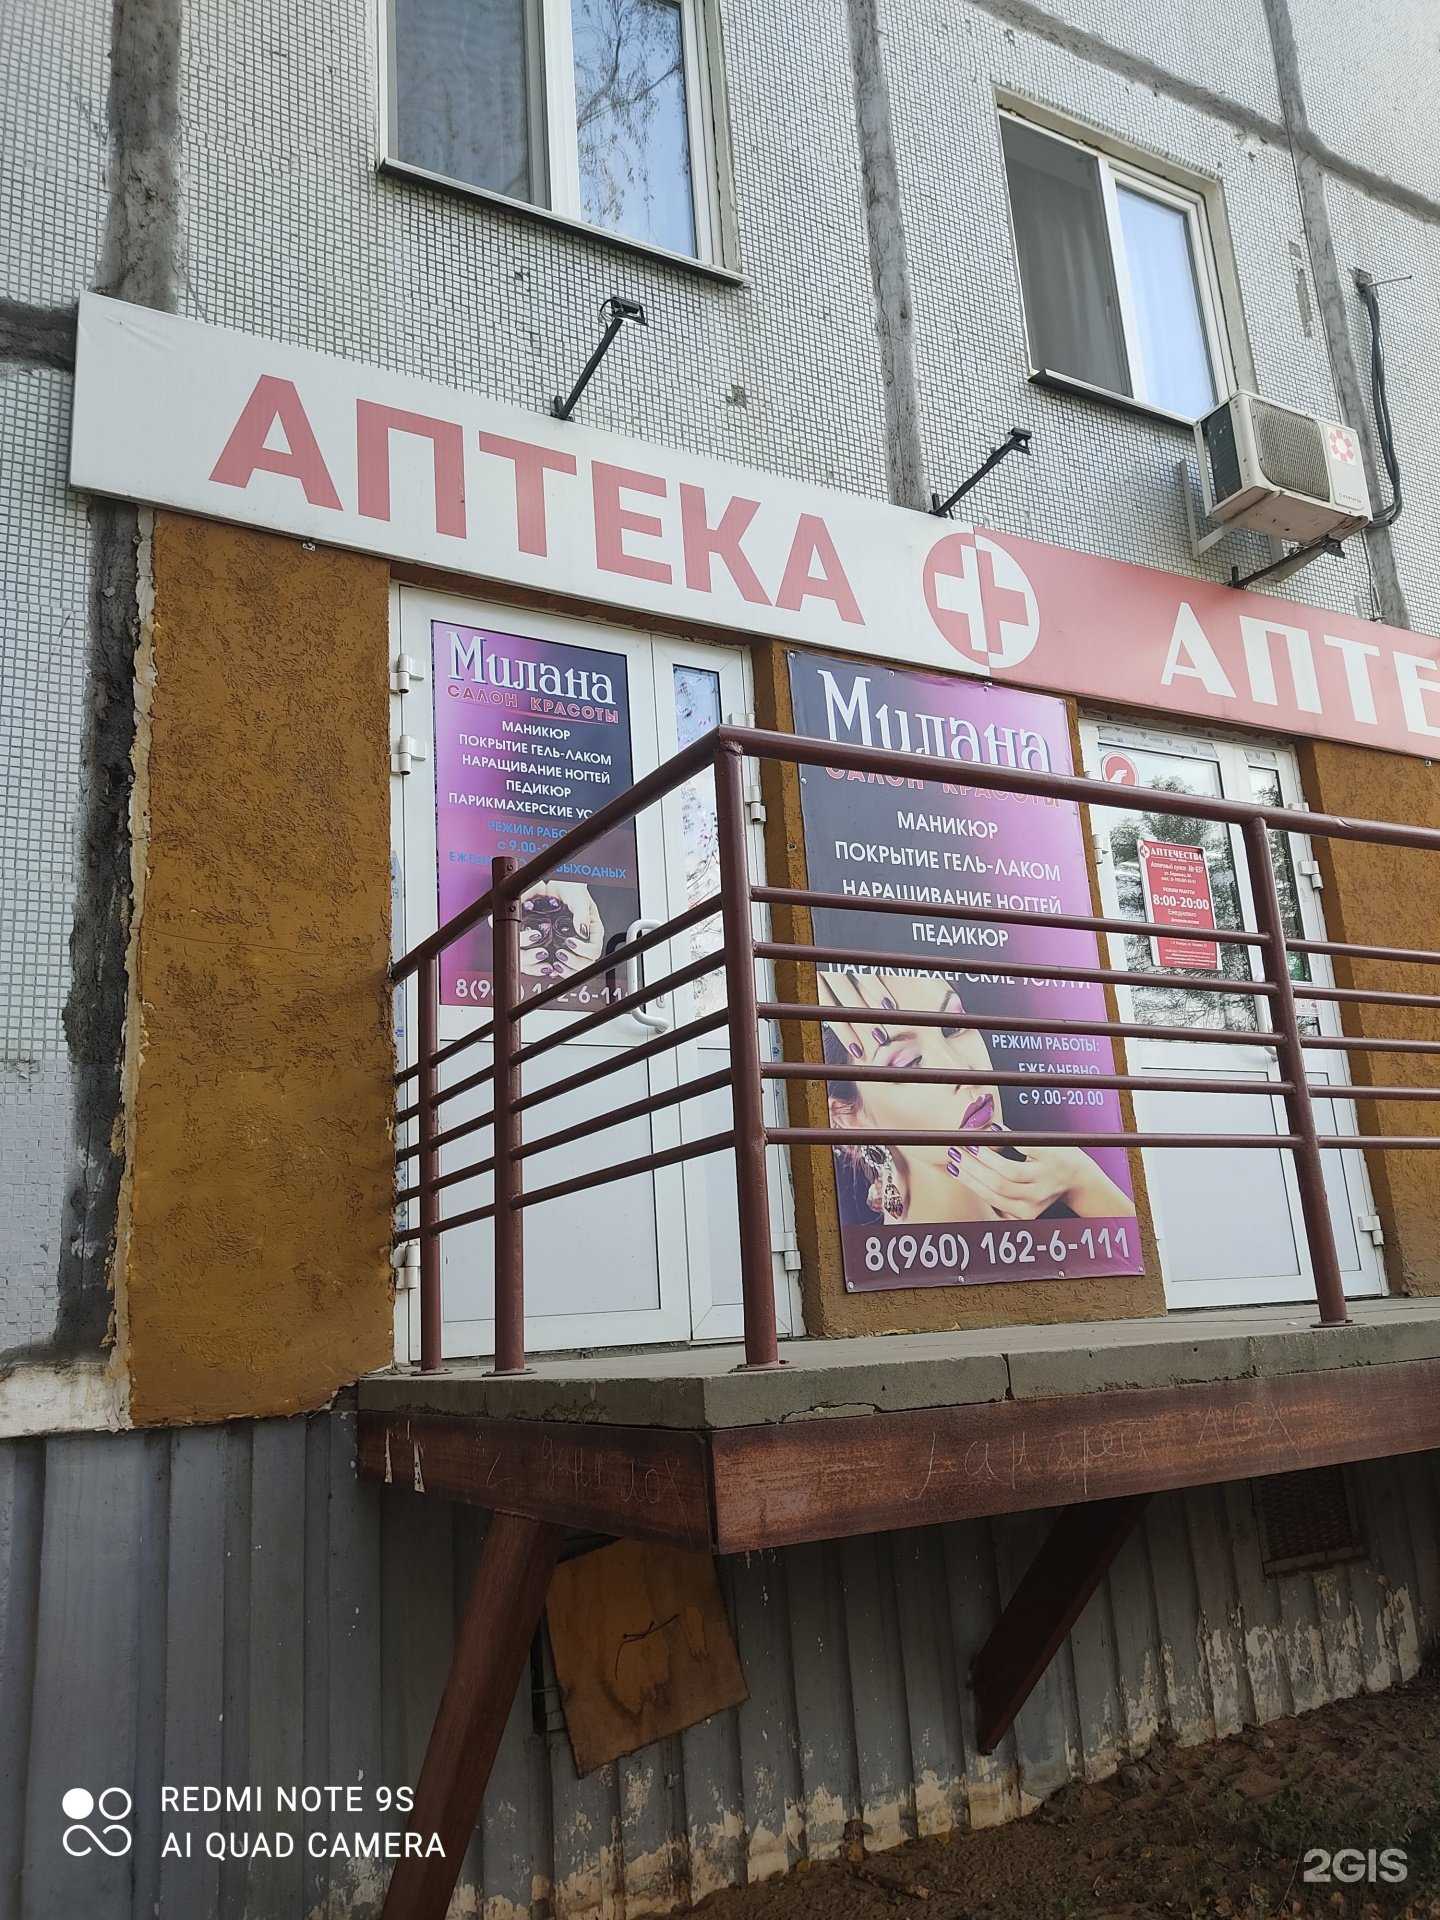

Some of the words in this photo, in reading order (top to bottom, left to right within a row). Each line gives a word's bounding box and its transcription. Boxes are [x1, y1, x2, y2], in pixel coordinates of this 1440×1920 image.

[208, 374, 865, 626] АПТЕКА
[447, 630, 616, 705] Милана
[448, 684, 518, 708] САЛОН
[530, 696, 619, 724] КРАСОТЫ
[502, 720, 571, 740] МАНИКЮР
[817, 669, 1053, 773] Милана
[459, 734, 528, 754] ПОКРЫТИЕ
[531, 744, 612, 765] ГЕЛЬ-ЛАКОМ
[462, 754, 562, 777] НАРАЩИВАНИЕ
[565, 769, 610, 785] НОГТЕЙ
[506, 780, 572, 798] ПЕДИКЮР
[449, 792, 573, 818] ПАРИКМАХЕРСКИЕ
[897, 811, 999, 839] МАНИКЮР
[835, 841, 939, 869] ПОКРЫТИЕ
[943, 852, 1061, 882] ГЕЛЬ-ЛАКОМ
[842, 879, 992, 908] НАРАЩИВАНИЕ
[1153, 894, 1210, 911] 8:00-20:00
[912, 922, 1009, 947] ПЕДИКЮР
[991, 1034, 1042, 1051] РЕЖИМ
[1045, 1036, 1100, 1053] РАБОТЫ:
[1031, 1089, 1104, 1106] 9.00-20.00
[864, 1232, 970, 1274] 8(960)
[980, 1227, 1130, 1264] 162-6-111
